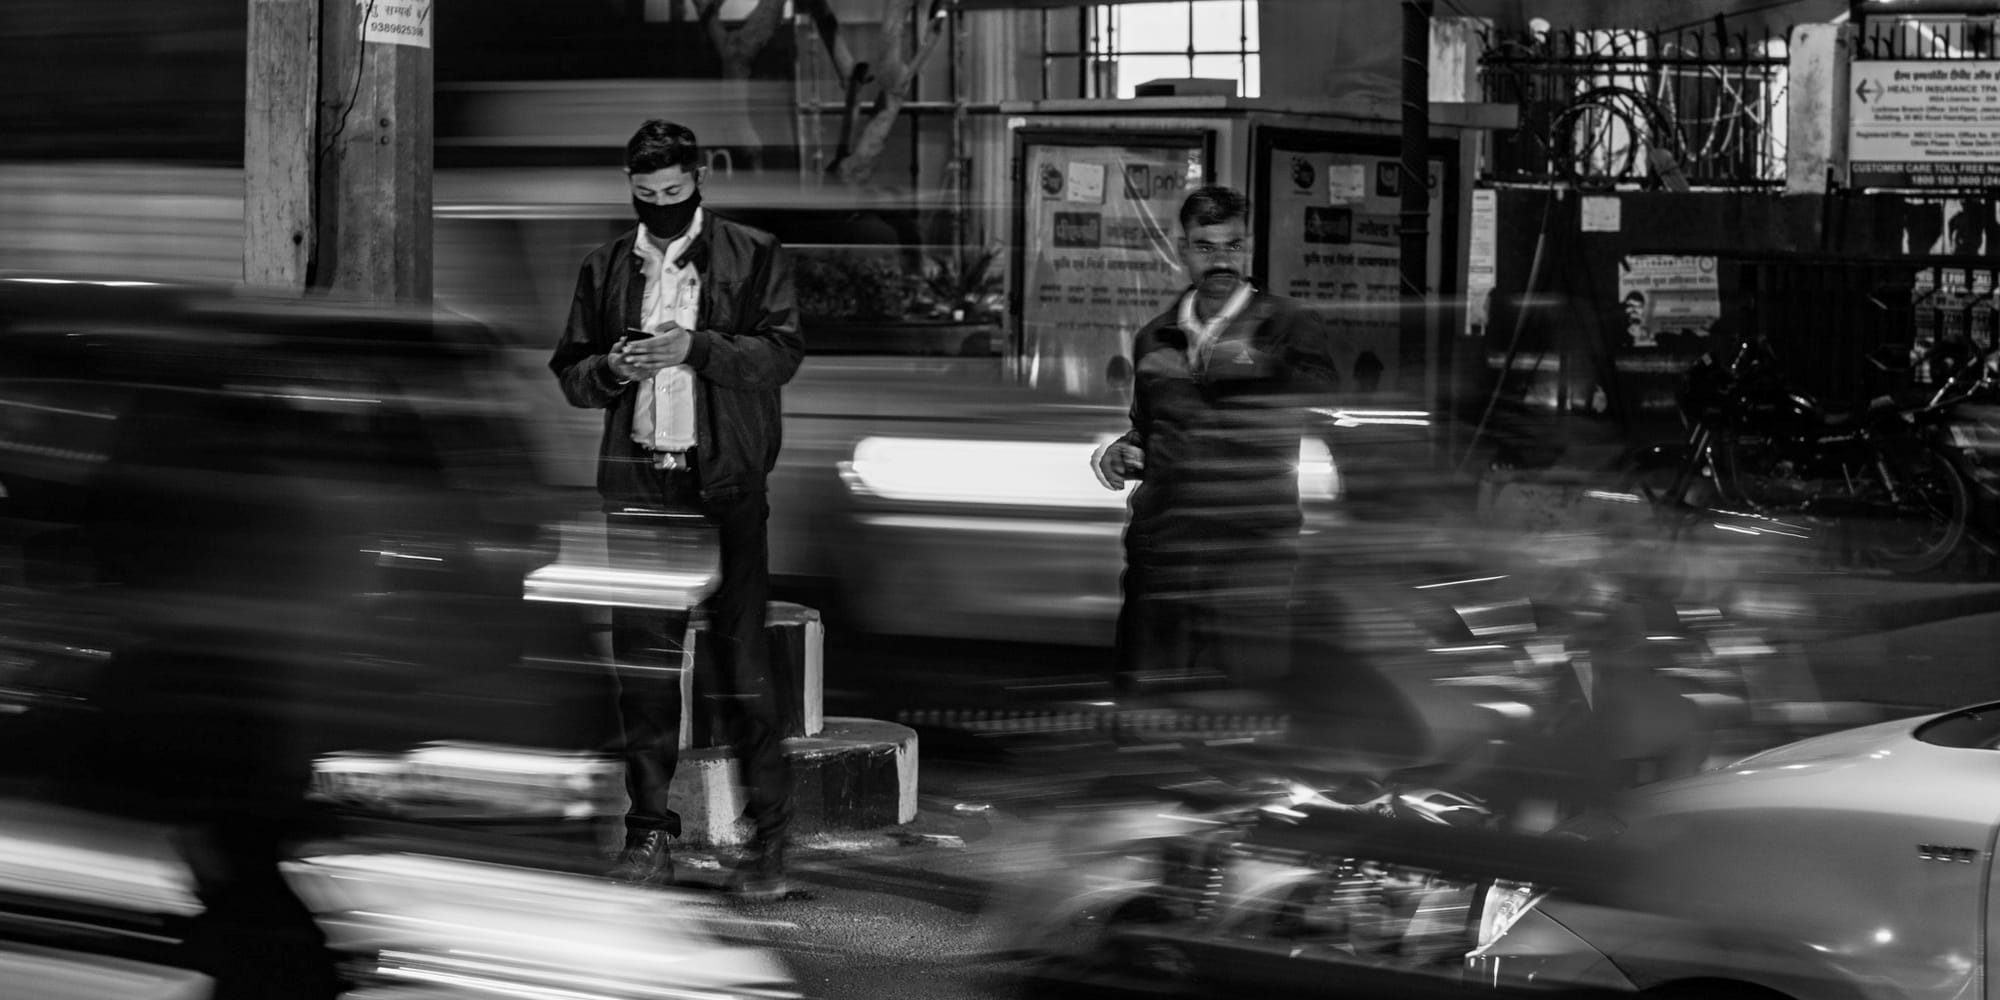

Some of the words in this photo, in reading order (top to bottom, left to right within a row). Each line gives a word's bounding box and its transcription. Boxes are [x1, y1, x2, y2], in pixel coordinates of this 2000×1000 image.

[1887, 85, 1923, 93] HEALTH
[1925, 85, 1977, 93] INSURANCE
[1981, 85, 1997, 93] TPA
[1852, 164, 1904, 173] CUSTOMER
[1905, 164, 1932, 173] CARE
[1934, 164, 1958, 173] TOLL
[1960, 164, 1985, 173] FREE
[1153, 169, 1187, 196] pnb
[1912, 175, 1935, 186] 1800
[1937, 175, 1955, 186] 180
